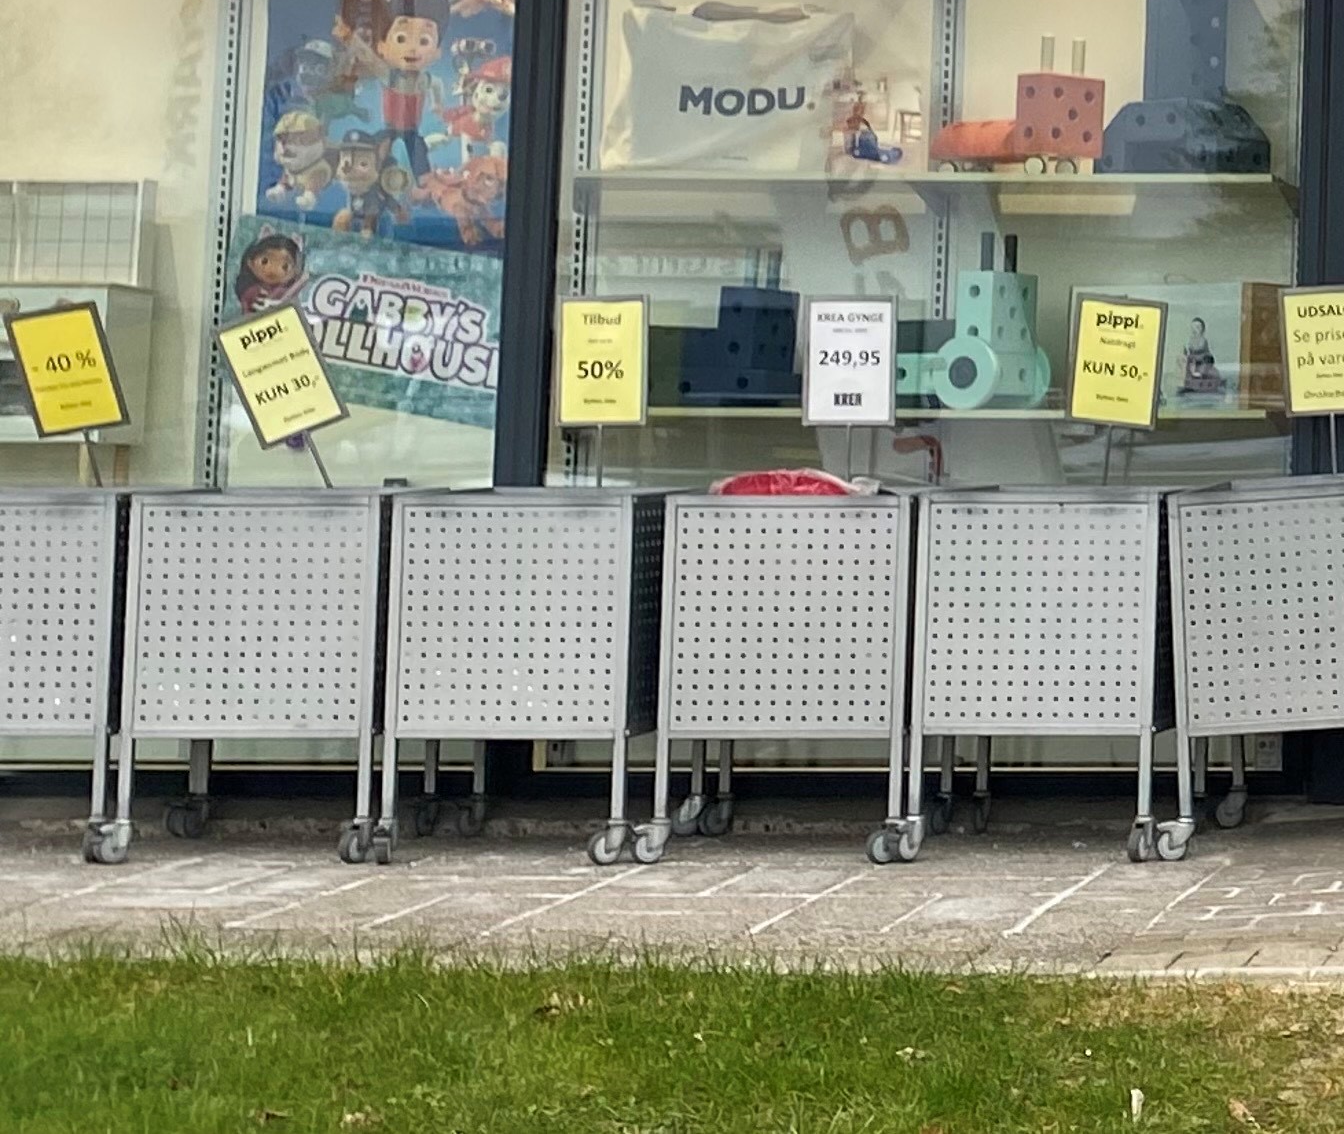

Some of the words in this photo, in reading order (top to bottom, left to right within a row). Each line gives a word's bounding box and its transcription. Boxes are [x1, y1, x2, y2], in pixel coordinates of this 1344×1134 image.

[313, 276, 487, 345] GABBY'S
[582, 313, 622, 325] Tilbud
[1292, 329, 1311, 344] Se
[45, 352, 72, 374] 40
[818, 350, 881, 369] 249,95
[1083, 359, 1115, 377] KUN
[1296, 351, 1316, 370] på
[576, 359, 625, 380] 50%
[254, 382, 290, 407] KUN
